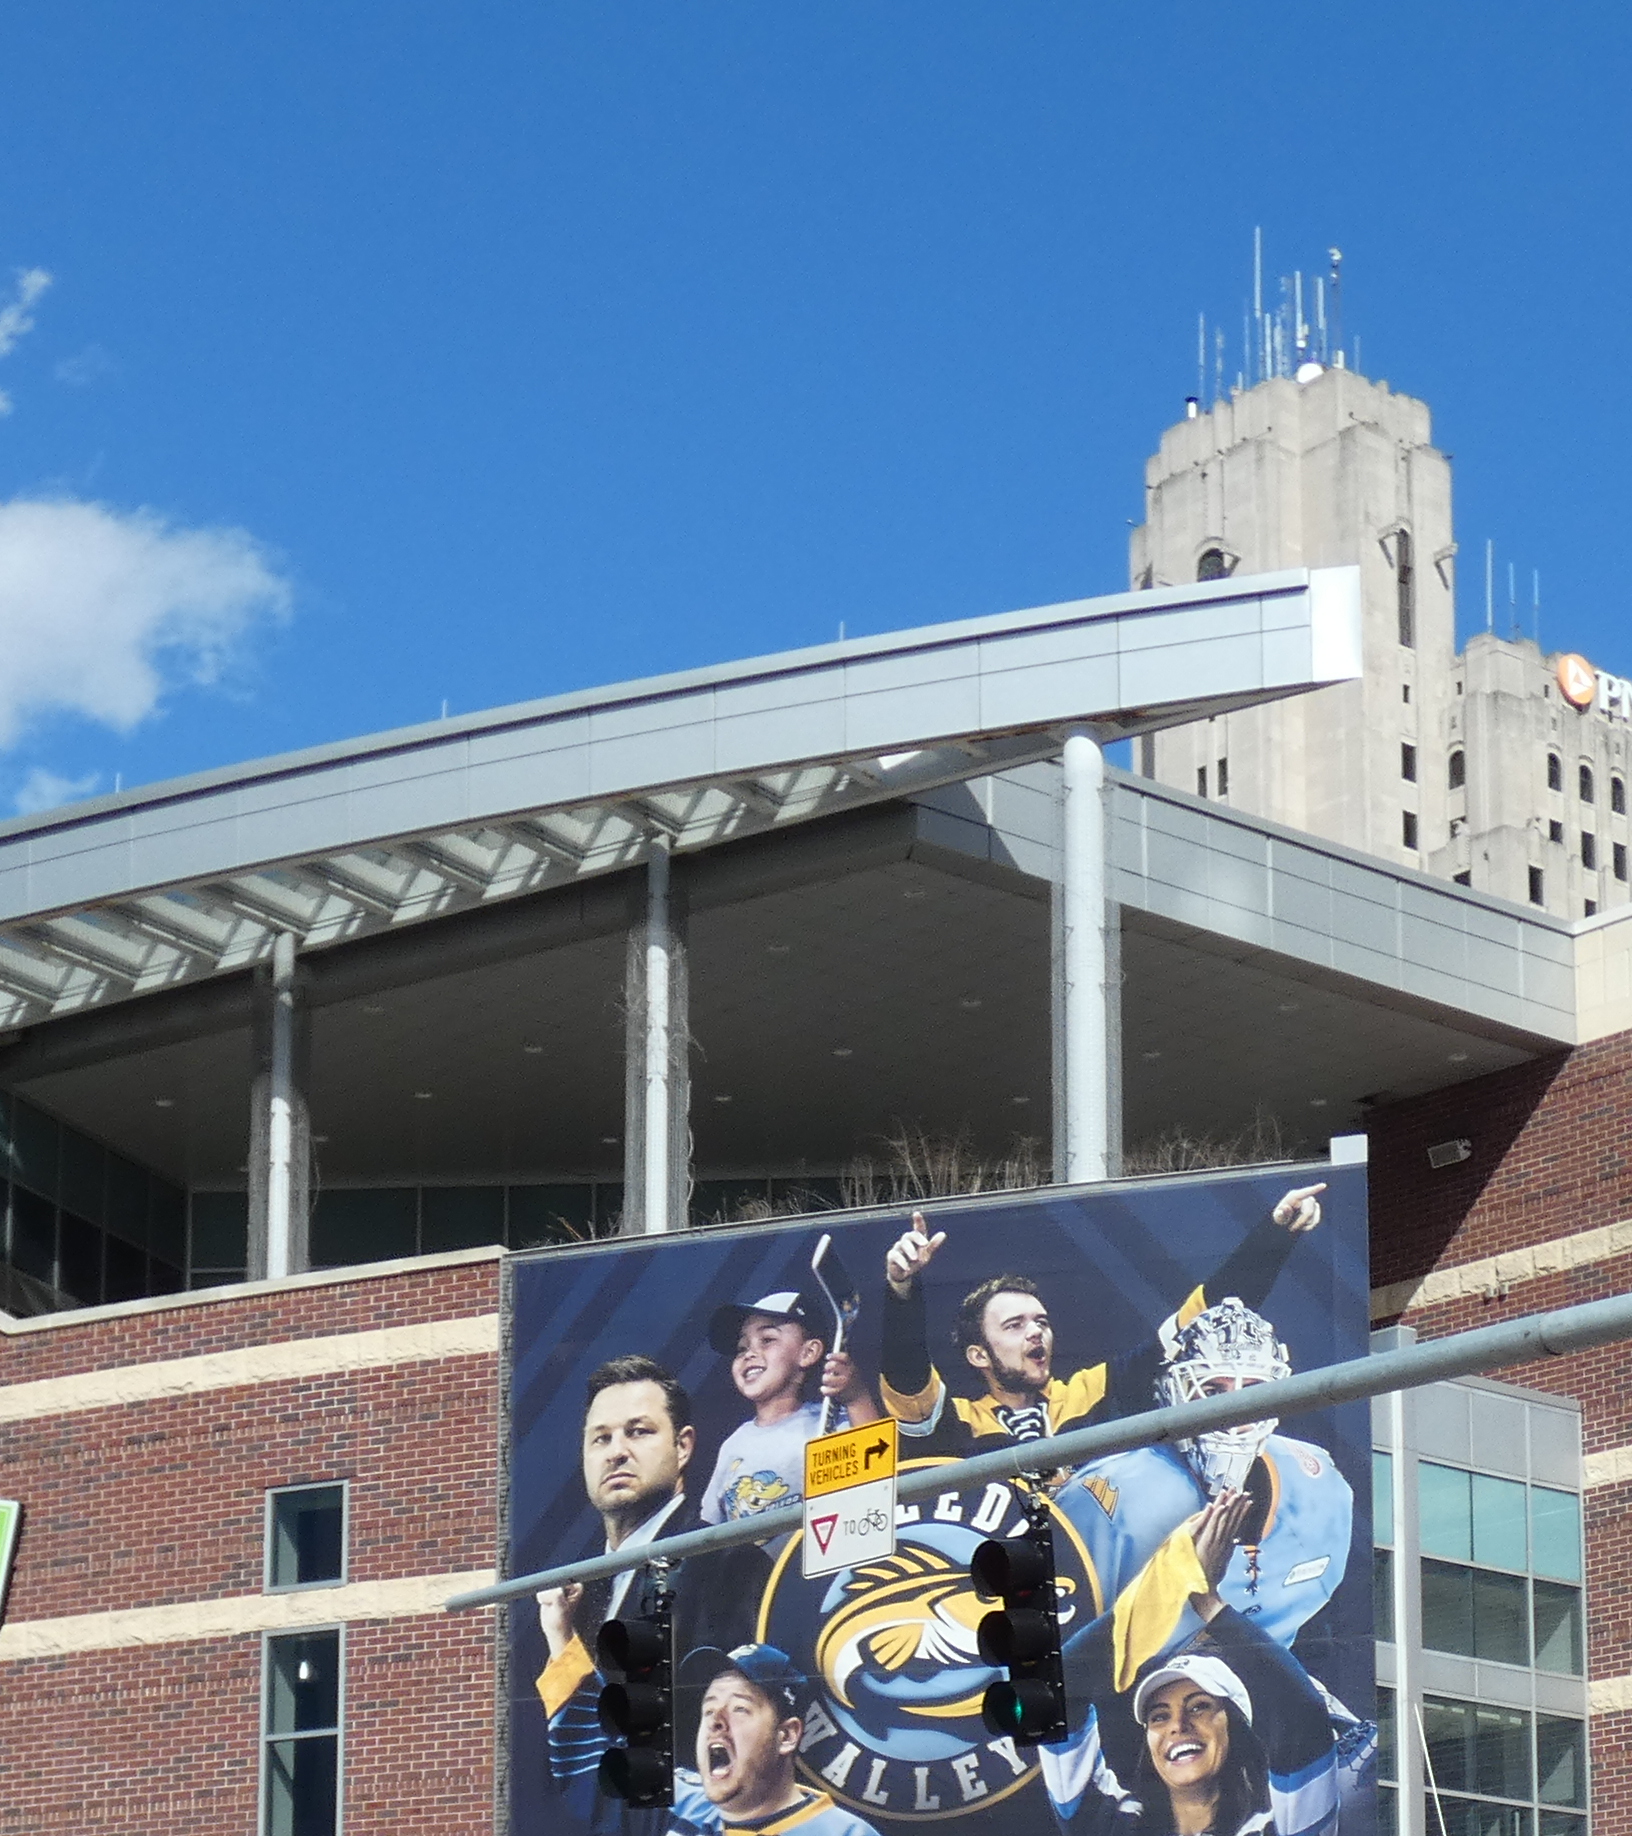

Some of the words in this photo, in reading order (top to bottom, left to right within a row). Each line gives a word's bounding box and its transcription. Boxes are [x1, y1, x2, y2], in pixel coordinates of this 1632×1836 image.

[812, 1443, 856, 1467] TURNING
[809, 1460, 859, 1486] VEHICLES
[843, 1520, 856, 1536] TO
[799, 1701, 1028, 1810] WALLEY
